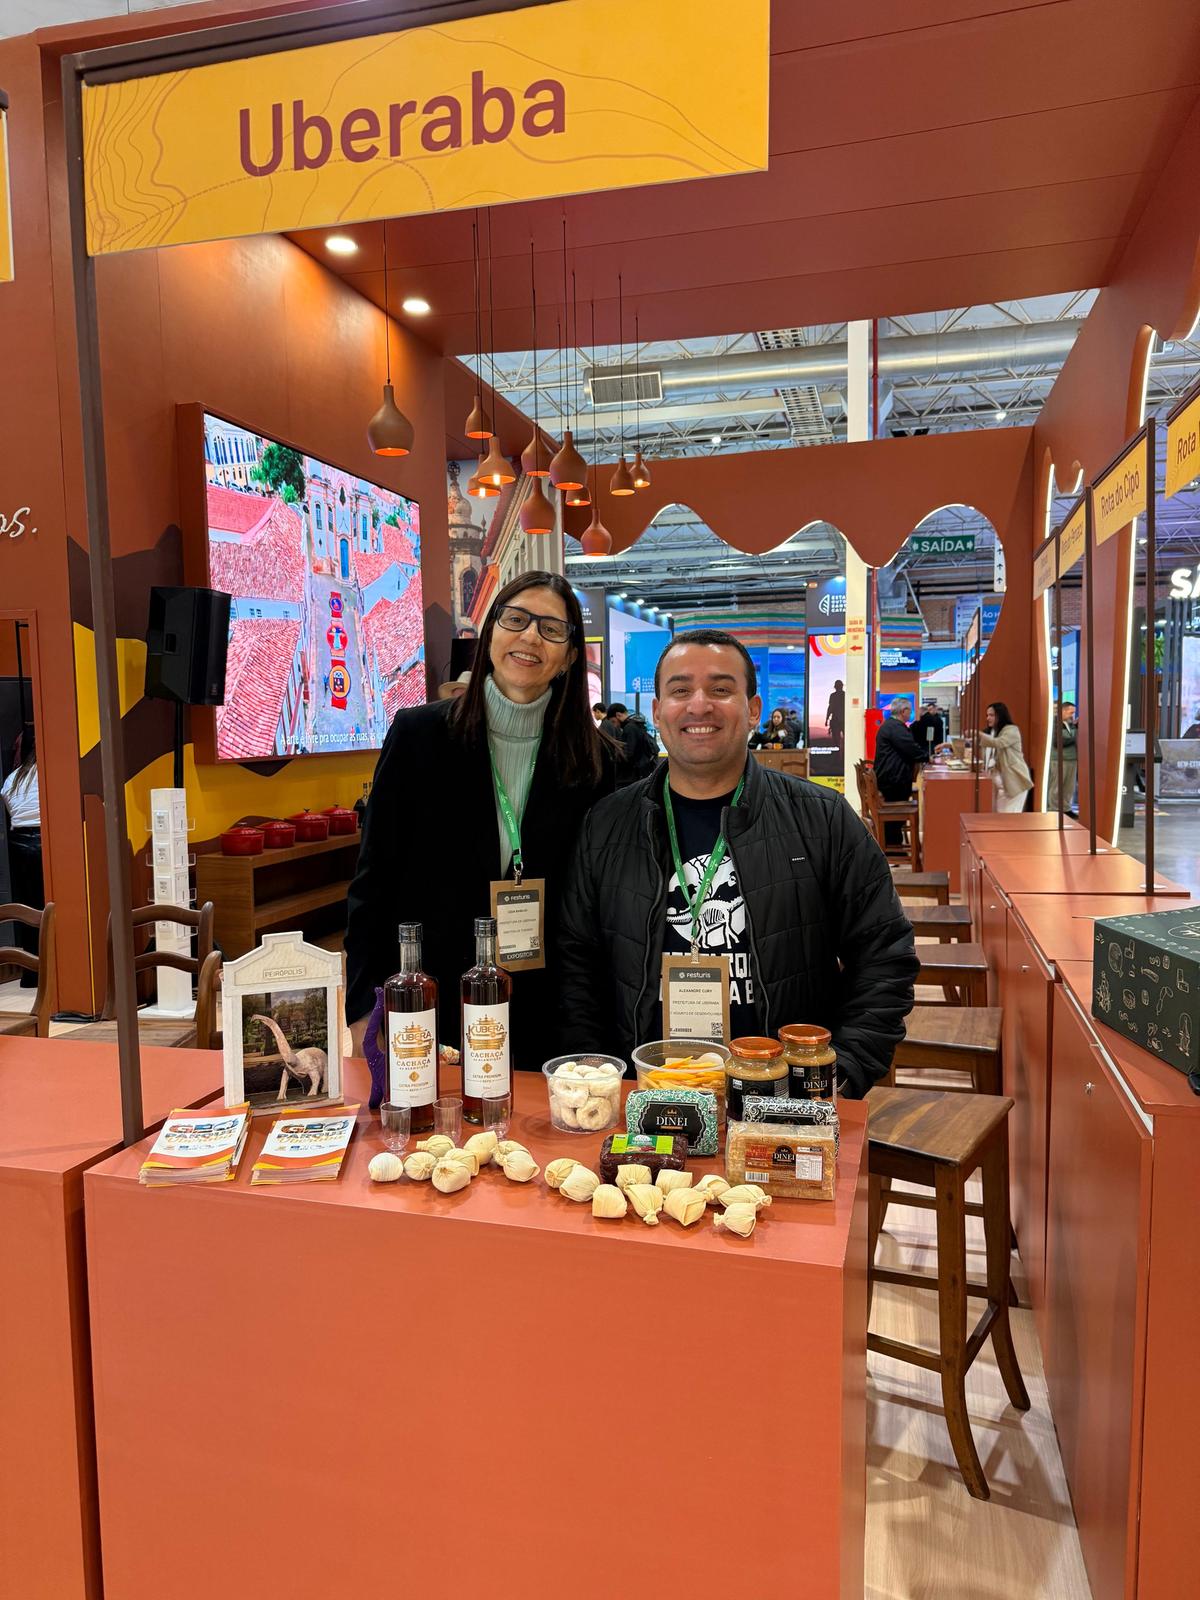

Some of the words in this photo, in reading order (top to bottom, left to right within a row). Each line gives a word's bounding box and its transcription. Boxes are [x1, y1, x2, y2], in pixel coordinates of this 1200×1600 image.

[239, 71, 566, 177] Uberaba
[1177, 432, 1196, 464] Rota
[1101, 493, 1115, 519] Rota
[1115, 490, 1123, 506] do
[1123, 465, 1140, 500] Cipó
[921, 538, 965, 553] SAÍDA
[320, 734, 330, 746] pra
[330, 733, 349, 745] ocupar
[468, 1023, 505, 1036] KUBERA
[393, 1031, 432, 1045] KUBERA
[470, 1051, 504, 1060] CACHAÇA
[397, 1058, 431, 1067] CACHAÇA
[803, 1080, 828, 1089] DINEI
[656, 1116, 688, 1127] DINEI
[774, 1152, 795, 1161] DINEI
